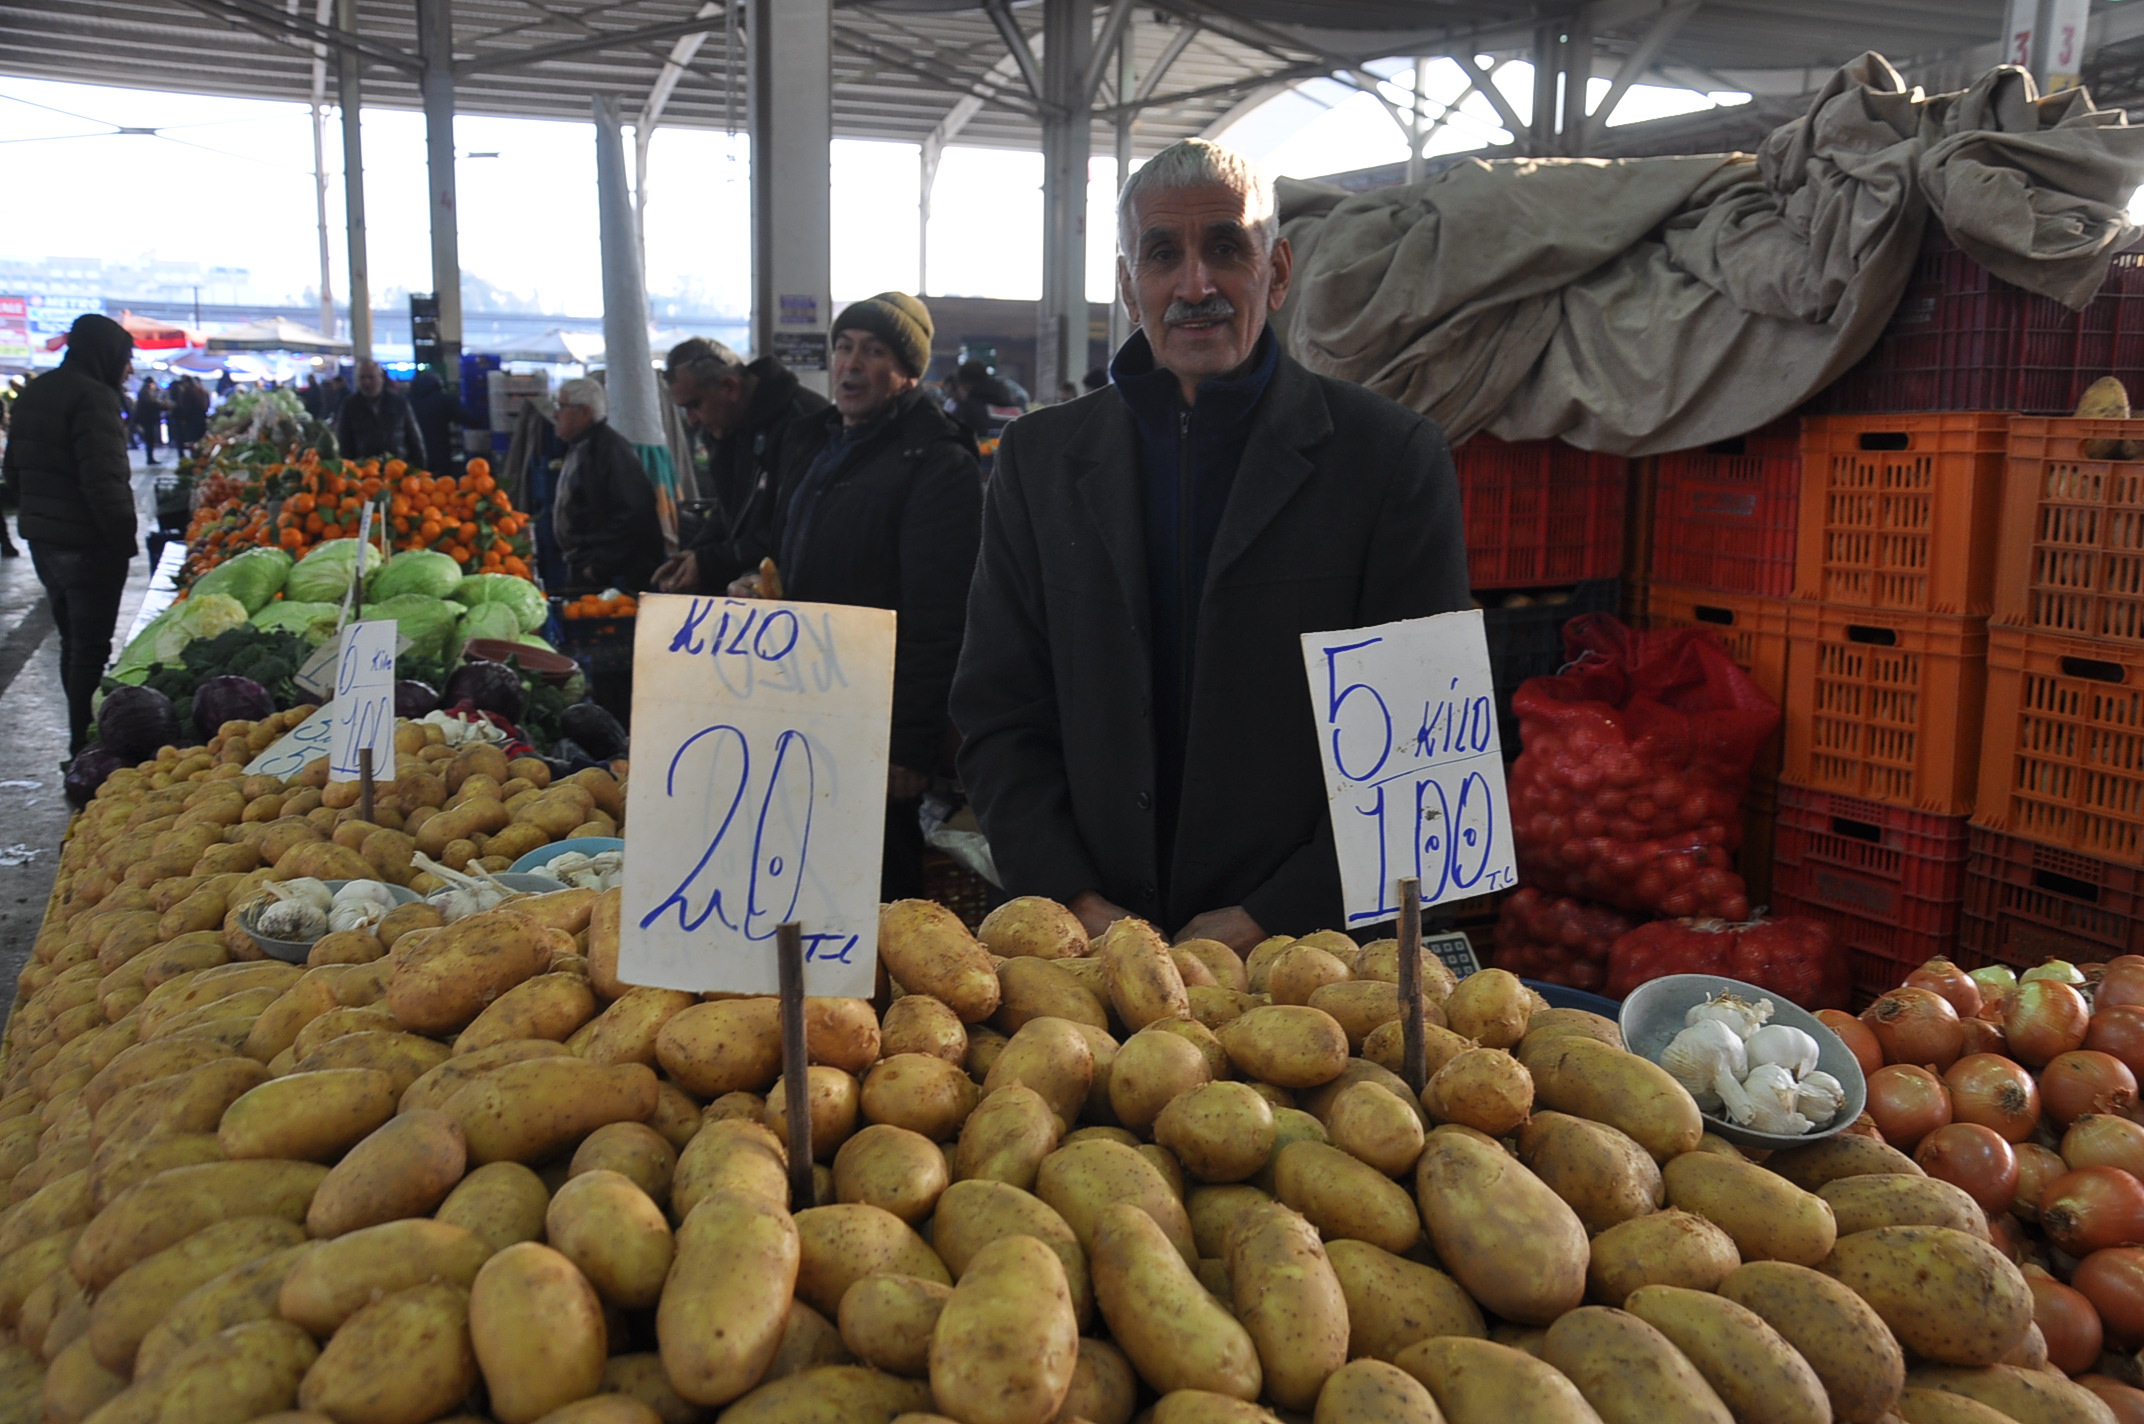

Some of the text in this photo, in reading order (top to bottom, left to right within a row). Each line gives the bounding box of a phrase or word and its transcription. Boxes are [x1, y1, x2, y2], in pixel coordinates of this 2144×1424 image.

[2012, 30, 2031, 66] 3
[2059, 26, 2075, 65] 3
[1322, 637, 1392, 782] 5
[639, 724, 814, 941] 20
[1348, 771, 1493, 922] 100
